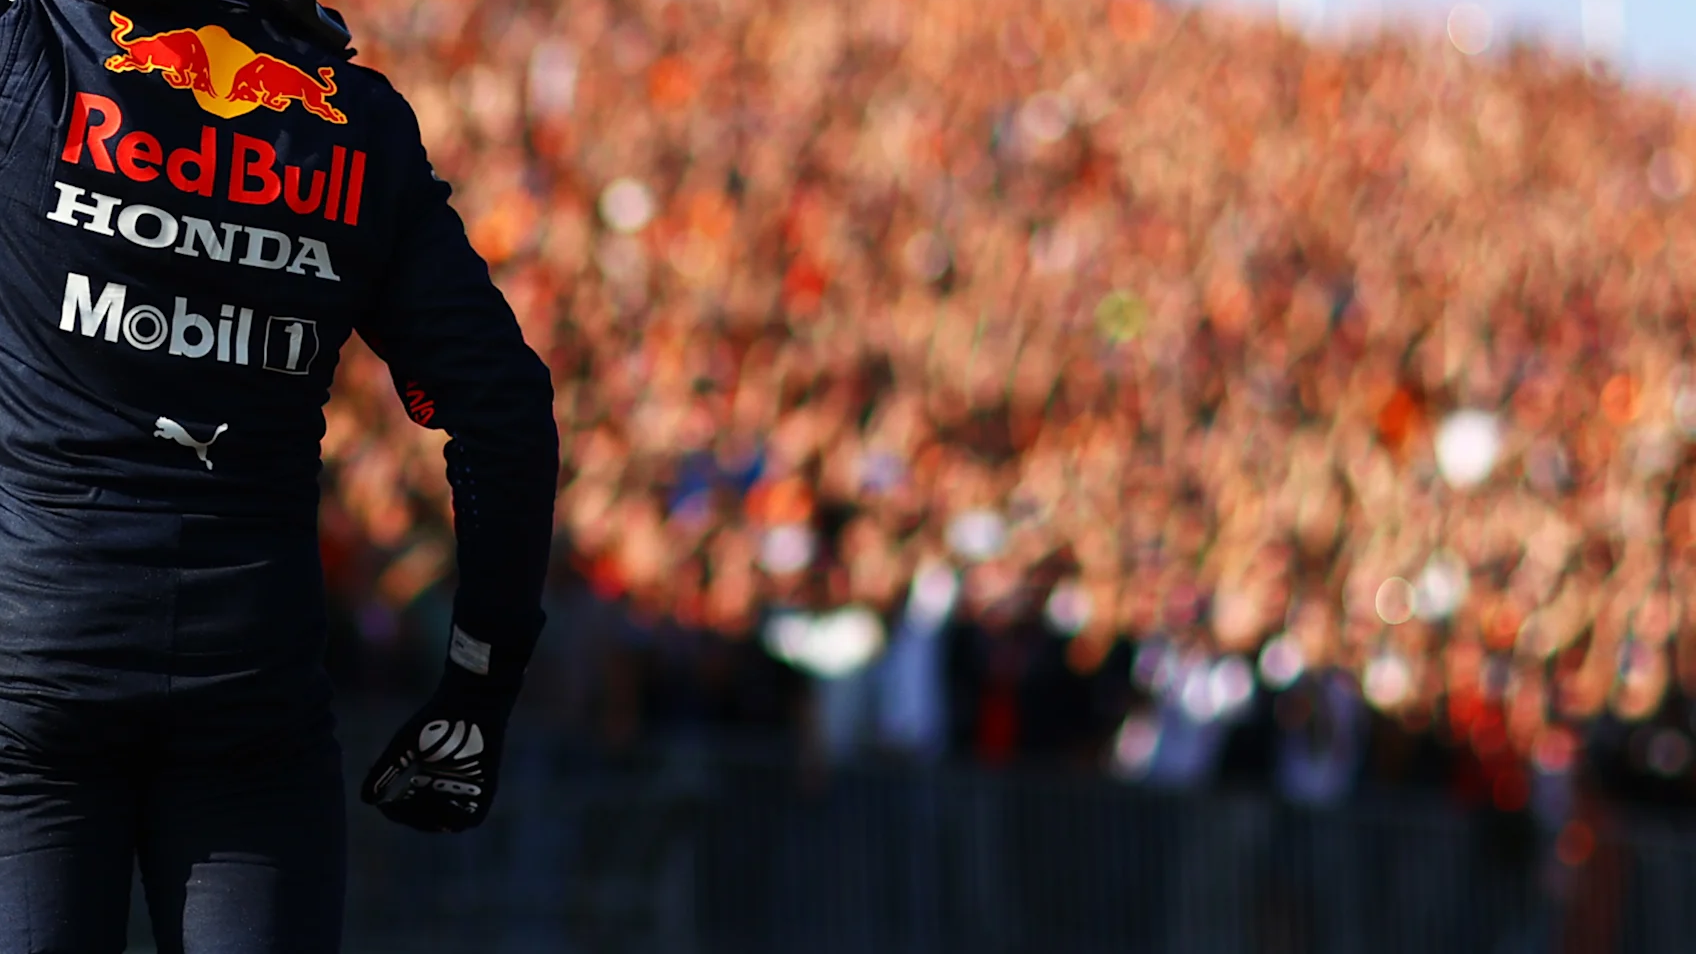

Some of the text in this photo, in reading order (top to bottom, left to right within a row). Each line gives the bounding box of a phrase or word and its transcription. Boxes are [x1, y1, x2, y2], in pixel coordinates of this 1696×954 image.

[61, 91, 368, 226] Red Bull
[46, 180, 341, 282] HONDA
[58, 272, 254, 366] Mobil
